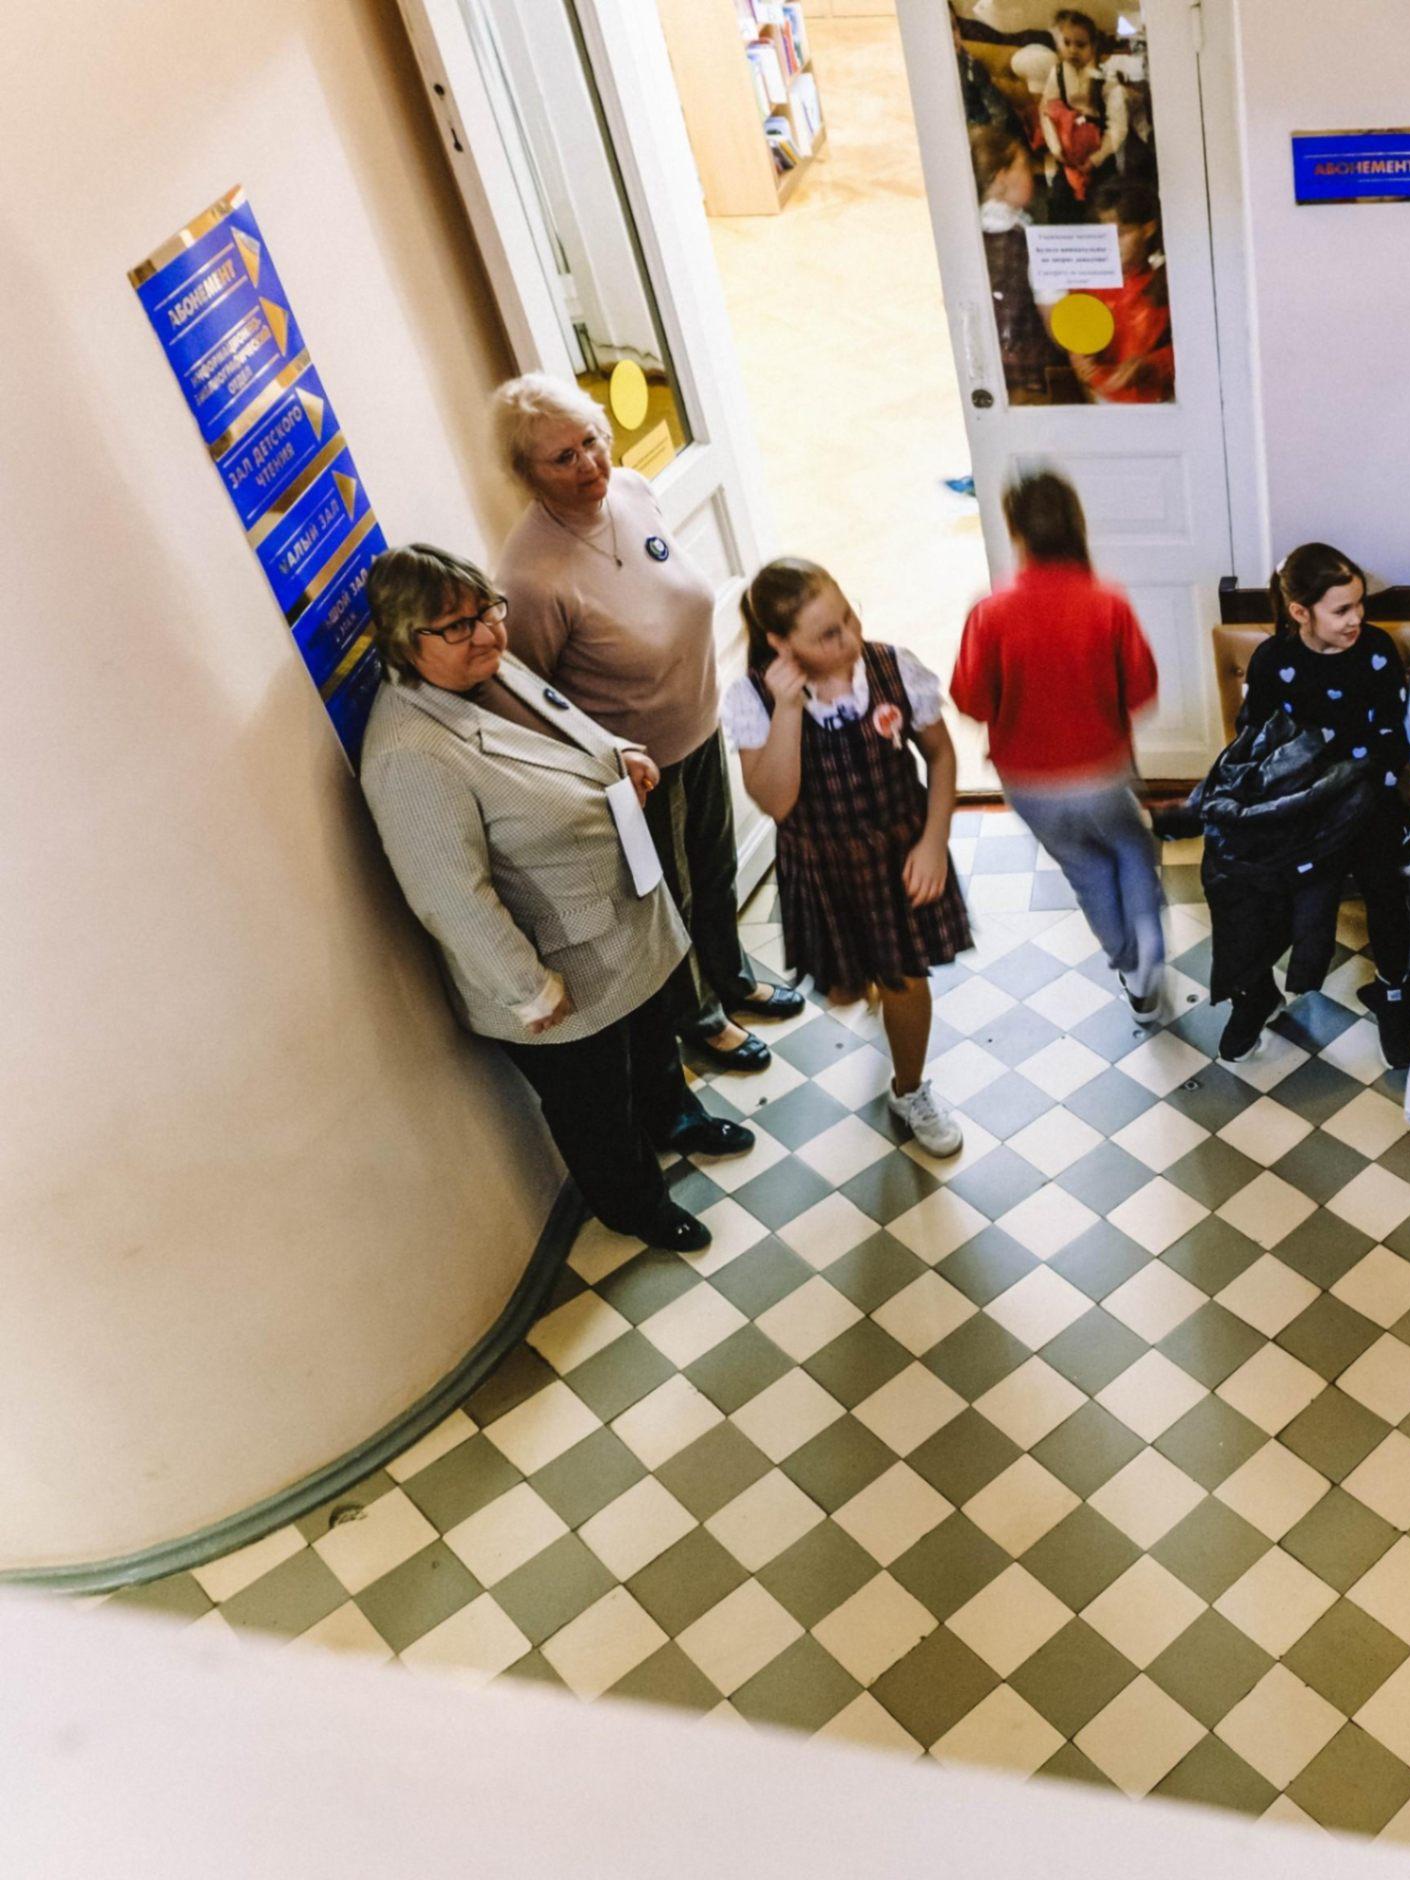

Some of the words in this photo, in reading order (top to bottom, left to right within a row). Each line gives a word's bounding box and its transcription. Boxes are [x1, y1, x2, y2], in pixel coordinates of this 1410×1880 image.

[168, 259, 236, 330] АБОНЕМЕНТ
[228, 457, 253, 489] ЗАЛ
[252, 405, 302, 467] ДЕТСКОГО
[255, 442, 294, 487] ЧТЕНИЯ
[317, 499, 340, 530] ЗАЛ
